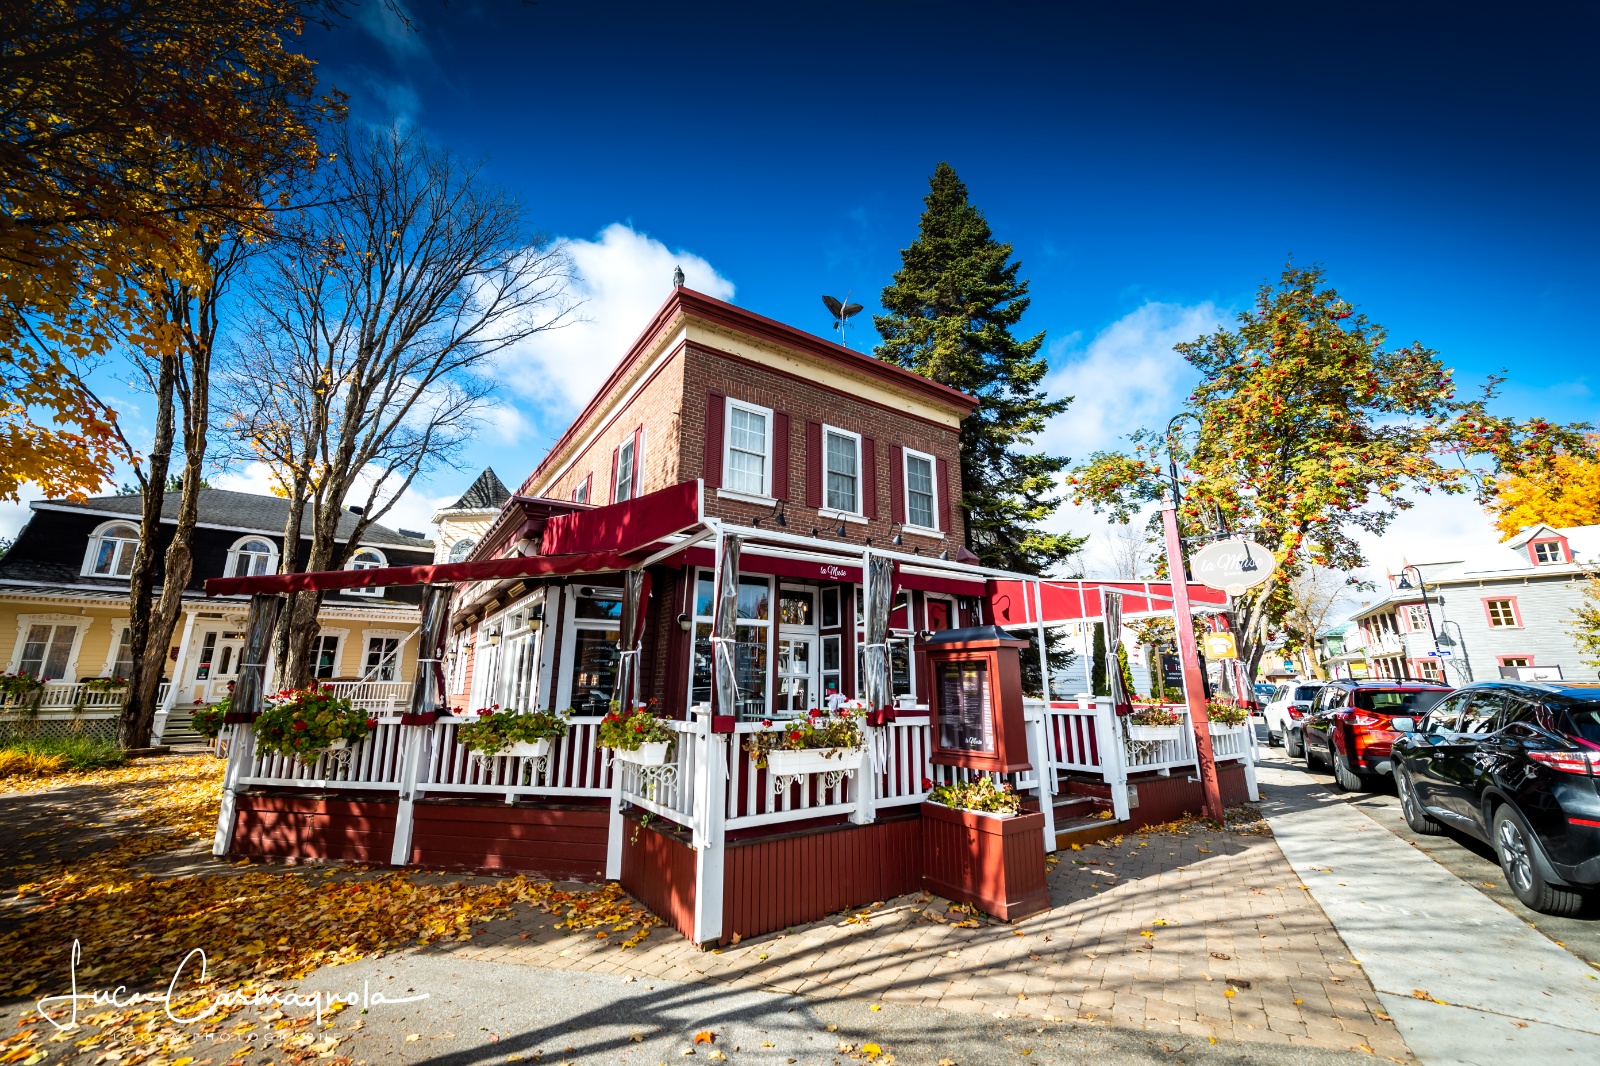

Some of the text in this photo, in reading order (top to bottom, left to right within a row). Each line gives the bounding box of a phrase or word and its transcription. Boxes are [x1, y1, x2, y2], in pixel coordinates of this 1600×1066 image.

[1201, 553, 1264, 572] la Muse
[827, 565, 847, 577] Muse
